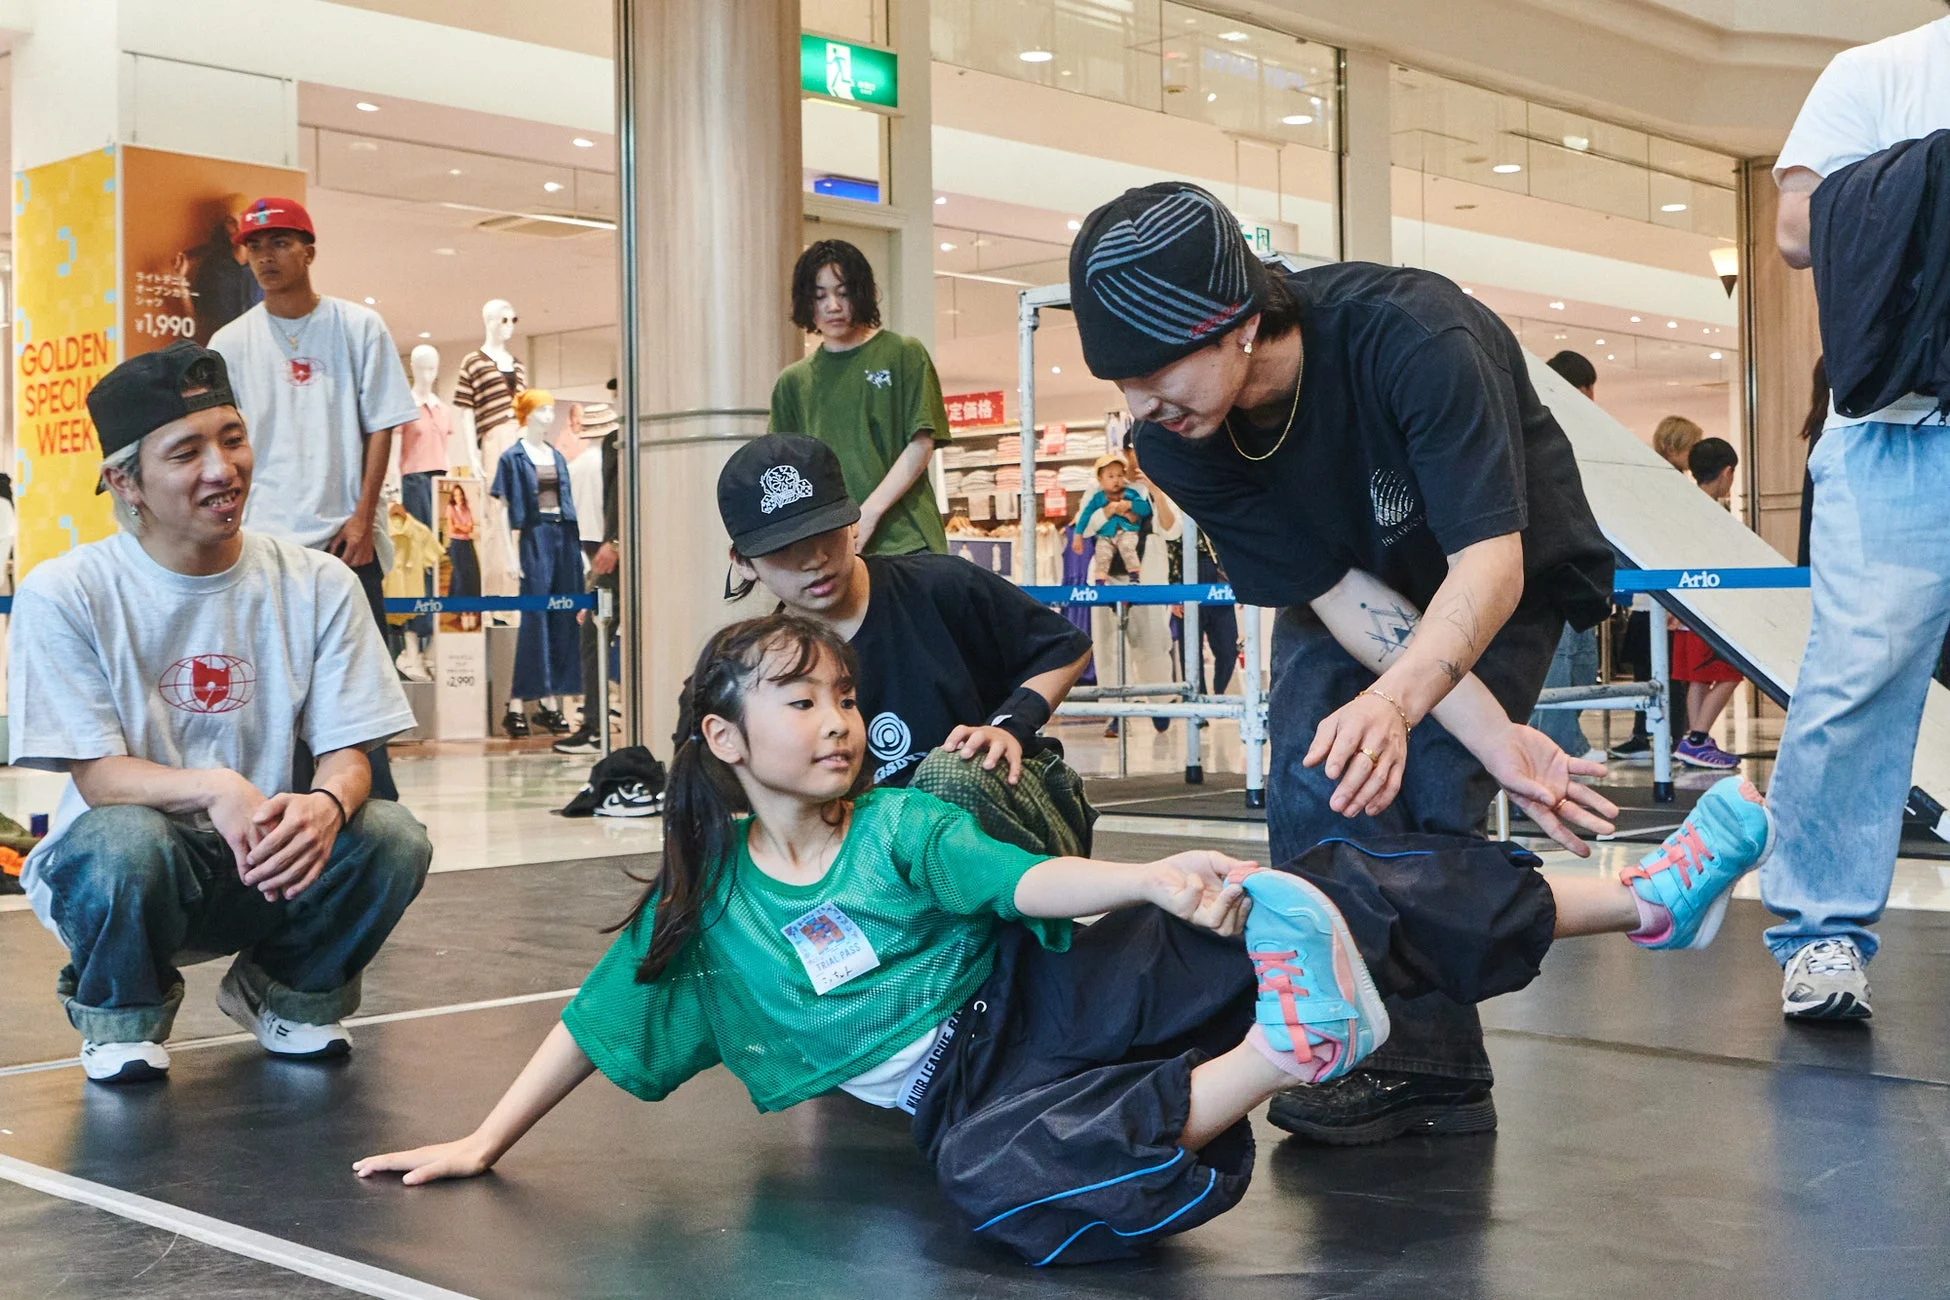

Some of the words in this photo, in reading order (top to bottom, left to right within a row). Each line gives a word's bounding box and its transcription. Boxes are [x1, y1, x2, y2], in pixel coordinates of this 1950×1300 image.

[134, 312, 196, 338] ¥1,990
[21, 331, 108, 377] GOLDEN
[25, 375, 100, 417] SPECIA
[944, 399, 993, 421] 定価格
[36, 418, 95, 457] WEEK
[1677, 570, 1721, 588] Ario
[413, 599, 443, 613] Ario
[547, 596, 574, 610] Ario
[1069, 587, 1099, 601] Ario
[815, 955, 841, 971] TRIAL
[840, 942, 862, 960] PASS
[905, 1078, 927, 1109] MAJOR
